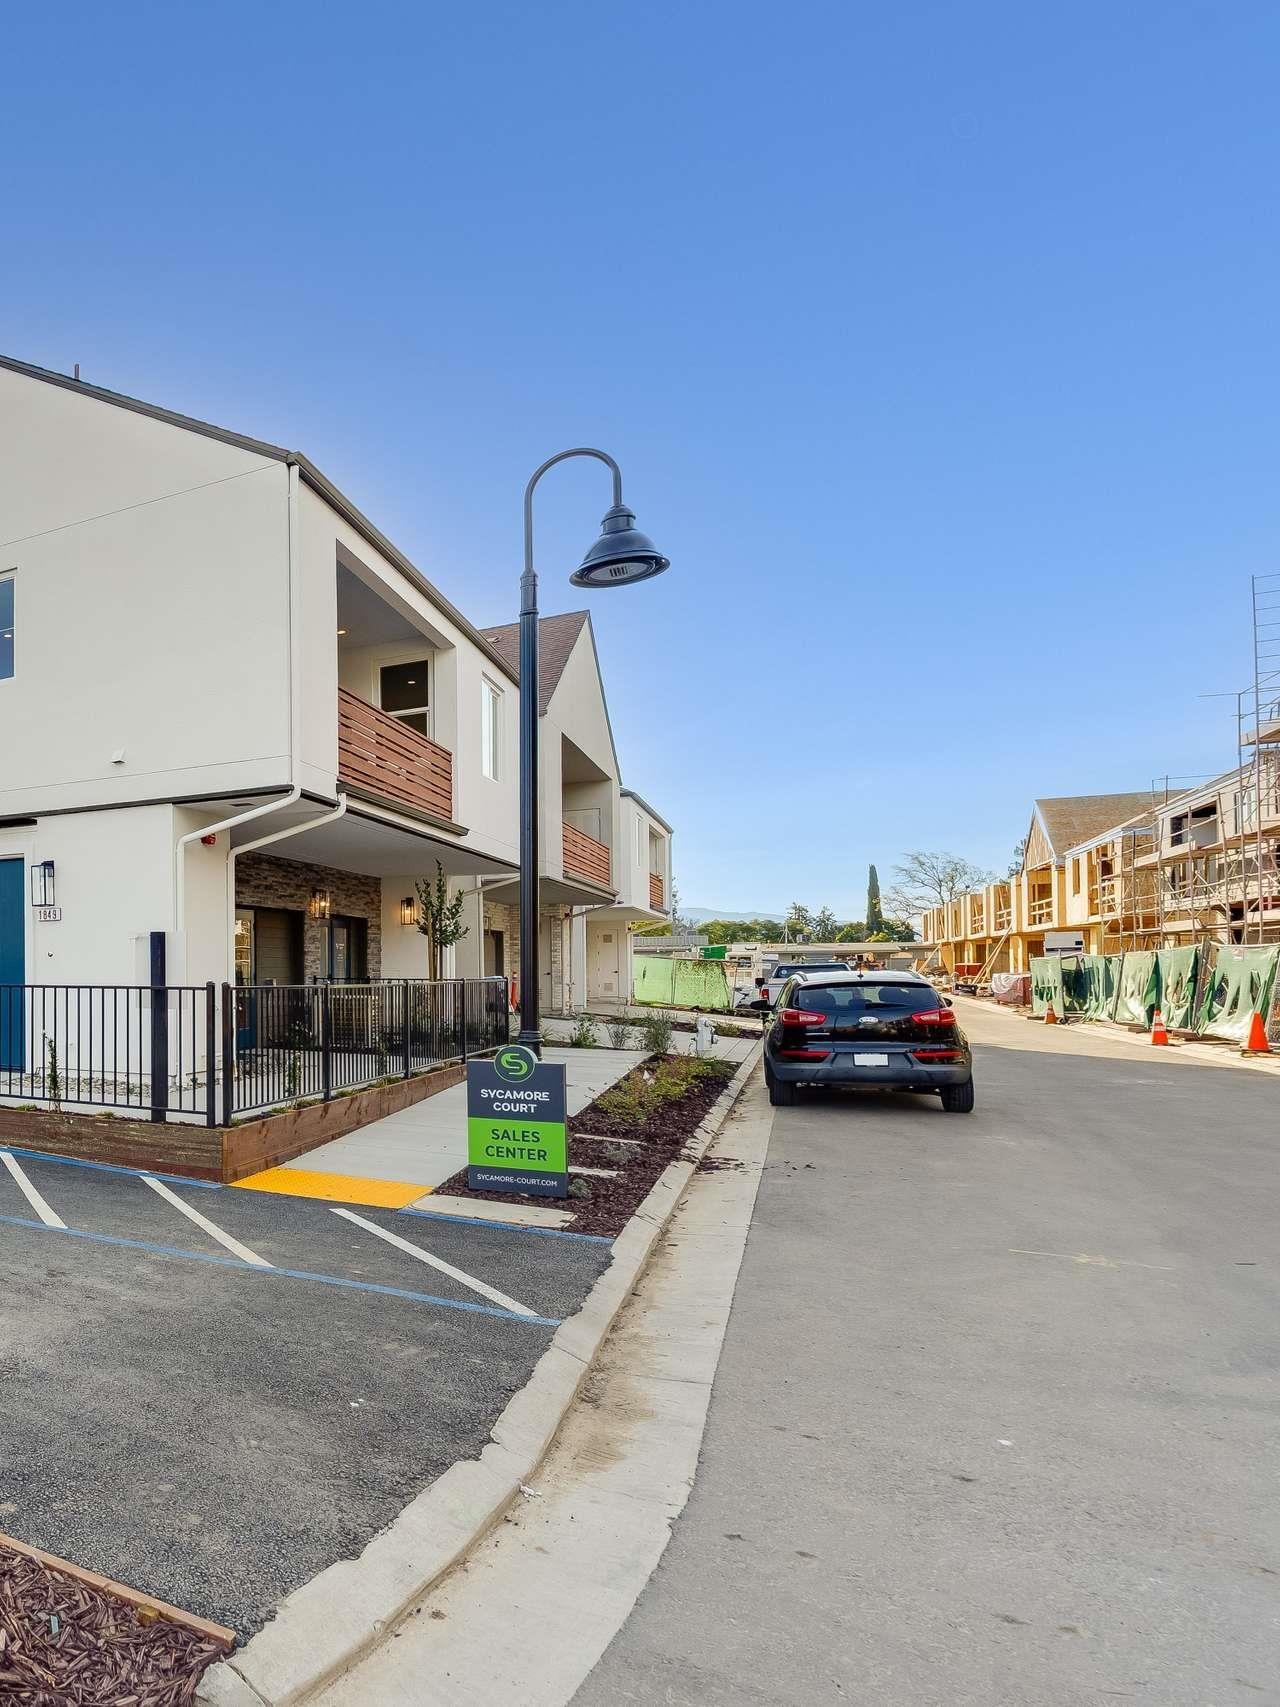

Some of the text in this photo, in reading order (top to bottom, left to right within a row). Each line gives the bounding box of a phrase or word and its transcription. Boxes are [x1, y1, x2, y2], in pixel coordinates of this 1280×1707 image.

[480, 1088, 550, 1102] SYCAMORE
[492, 1102, 538, 1113] COURT
[491, 1128, 541, 1143] SALES
[485, 1145, 548, 1162] CENTER
[476, 1173, 558, 1187] SYCAMORE-COURT.COM
